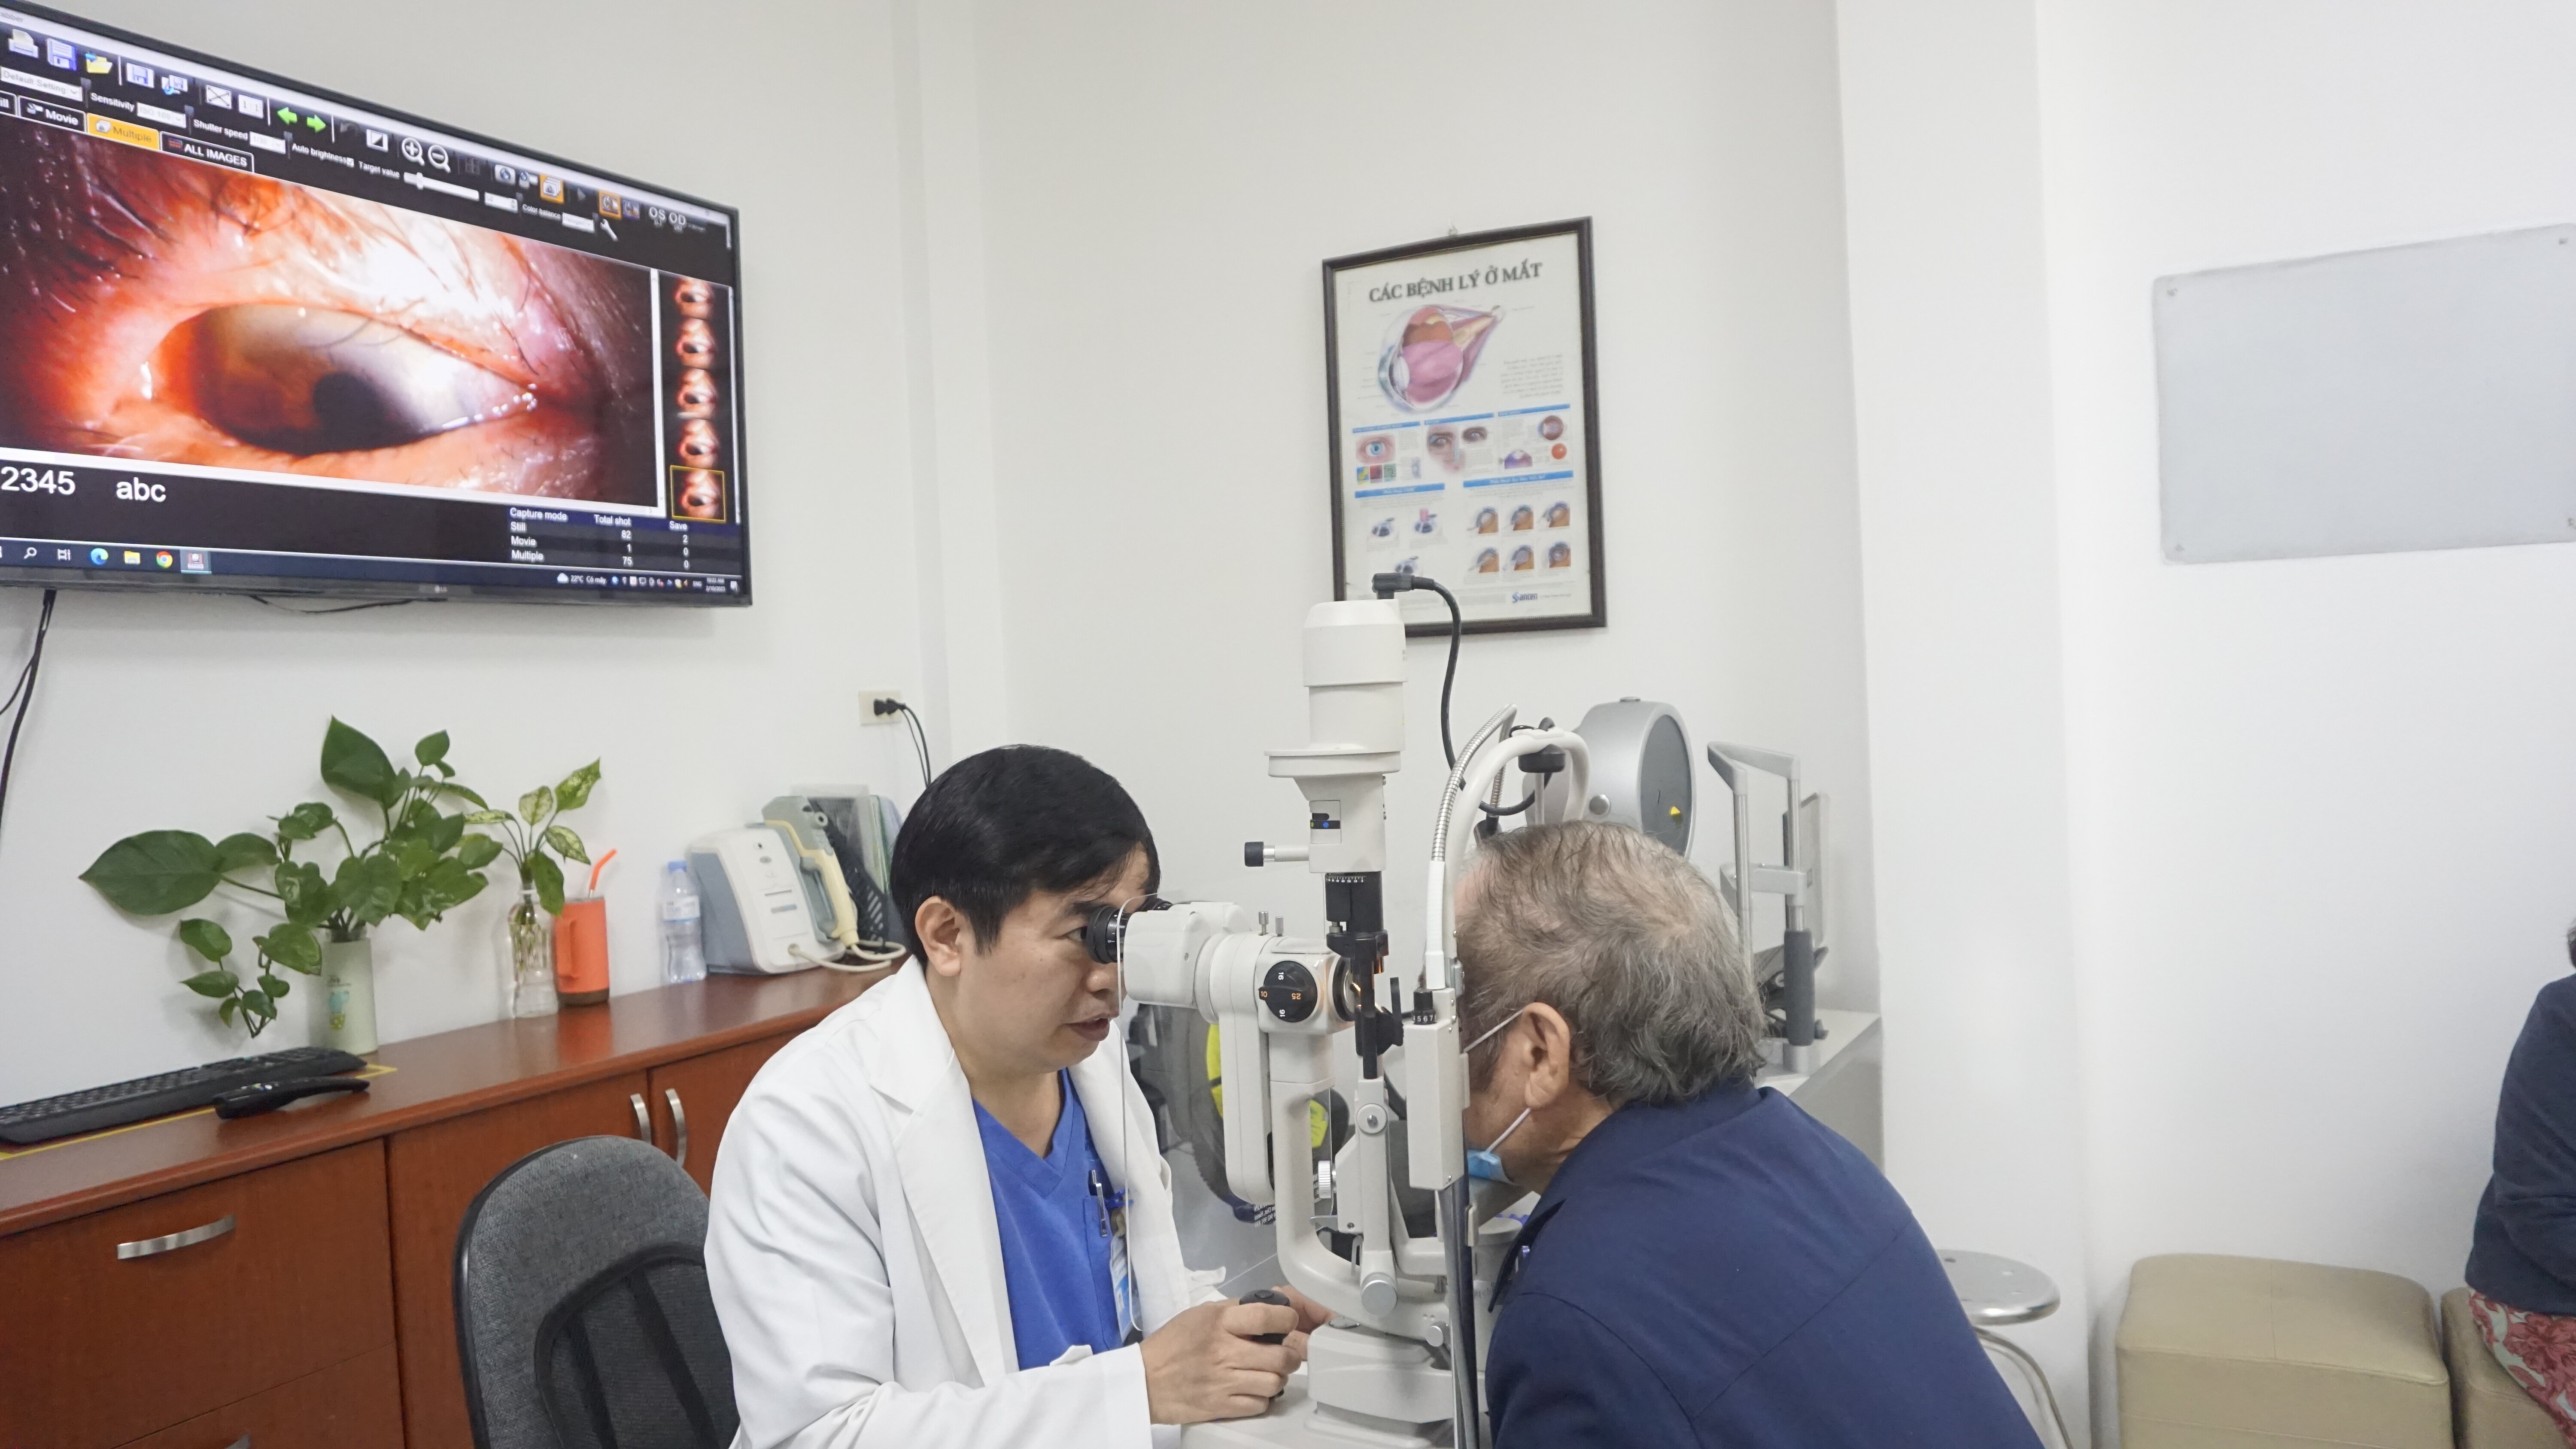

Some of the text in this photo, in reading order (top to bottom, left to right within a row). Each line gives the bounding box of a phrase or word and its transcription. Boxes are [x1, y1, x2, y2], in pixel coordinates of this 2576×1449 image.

[3, 71, 67, 94] Default Setting
[91, 92, 135, 113] Sensitivity
[45, 108, 79, 126] Movie
[113, 126, 152, 142] Multiple
[193, 119, 249, 141] Shutter speed
[184, 143, 248, 167] ALL IMAGES
[292, 143, 348, 165] Auto brightness
[358, 161, 400, 180] Target value
[522, 203, 562, 221] Color balance
[649, 207, 665, 221] OS
[669, 212, 686, 226] OD
[1369, 258, 1543, 301] CÁC BỆNH LÝ Ở MẮT
[0, 466, 76, 495] 2345
[116, 477, 167, 502] abc
[510, 507, 568, 522] Capture mode
[594, 514, 632, 527] Total shot
[510, 521, 527, 532] Still
[669, 521, 688, 531] Save
[511, 535, 537, 548] Movie
[621, 530, 632, 540] 82
[683, 534, 688, 544] 2
[627, 543, 632, 553] 1
[683, 547, 689, 557] 0
[511, 549, 545, 563] Multiple
[623, 556, 633, 567] 75
[683, 560, 690, 570] 0
[1278, 972, 1284, 980] 16
[1279, 1009, 1285, 1017] 16
